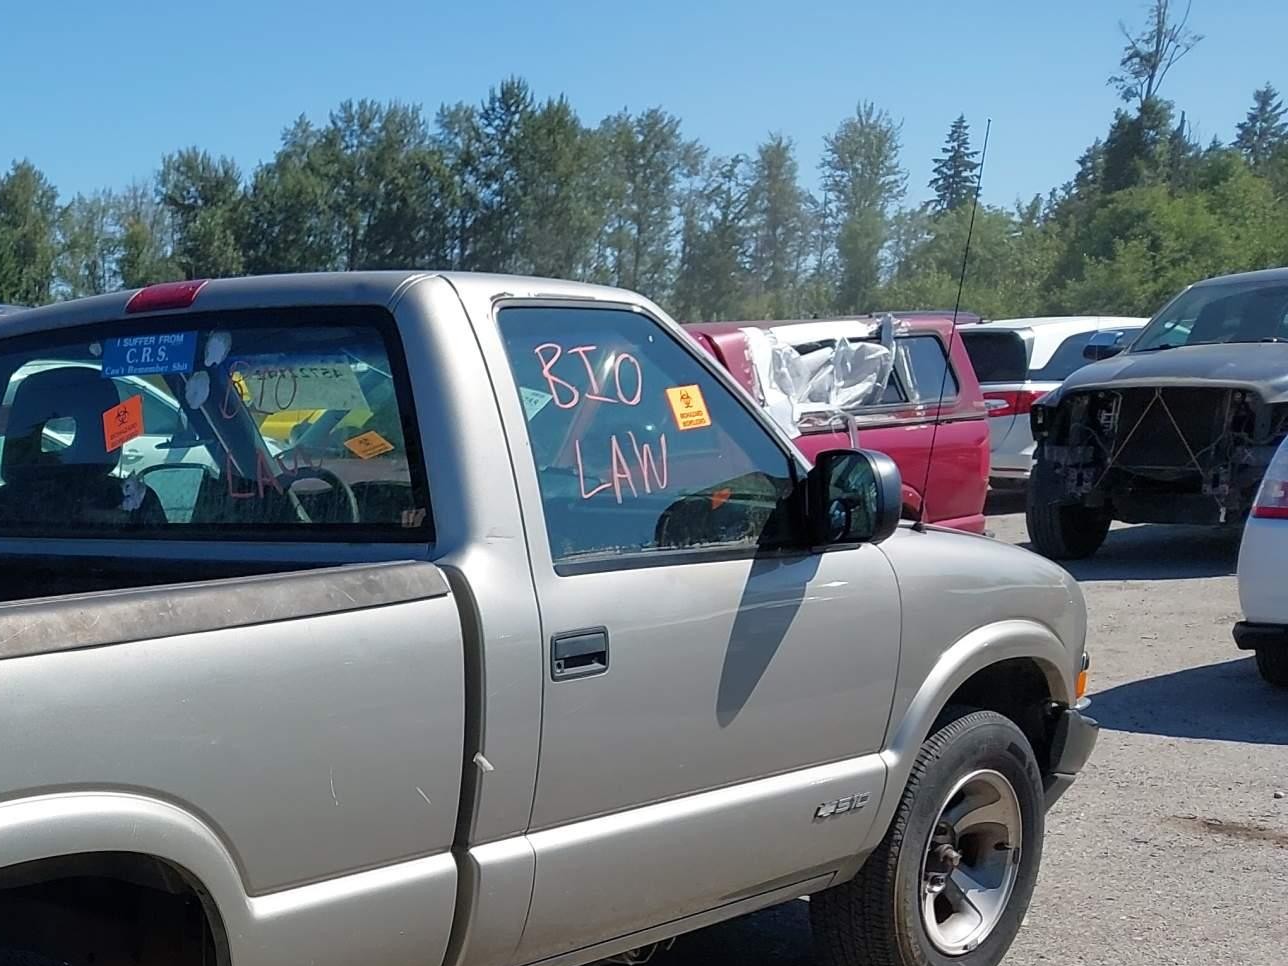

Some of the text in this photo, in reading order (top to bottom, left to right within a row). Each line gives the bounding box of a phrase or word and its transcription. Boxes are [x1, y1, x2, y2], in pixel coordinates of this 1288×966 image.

[116, 333, 185, 348] I SUFFER FROM
[534, 343, 643, 409] BIO
[575, 430, 668, 505] LAW
